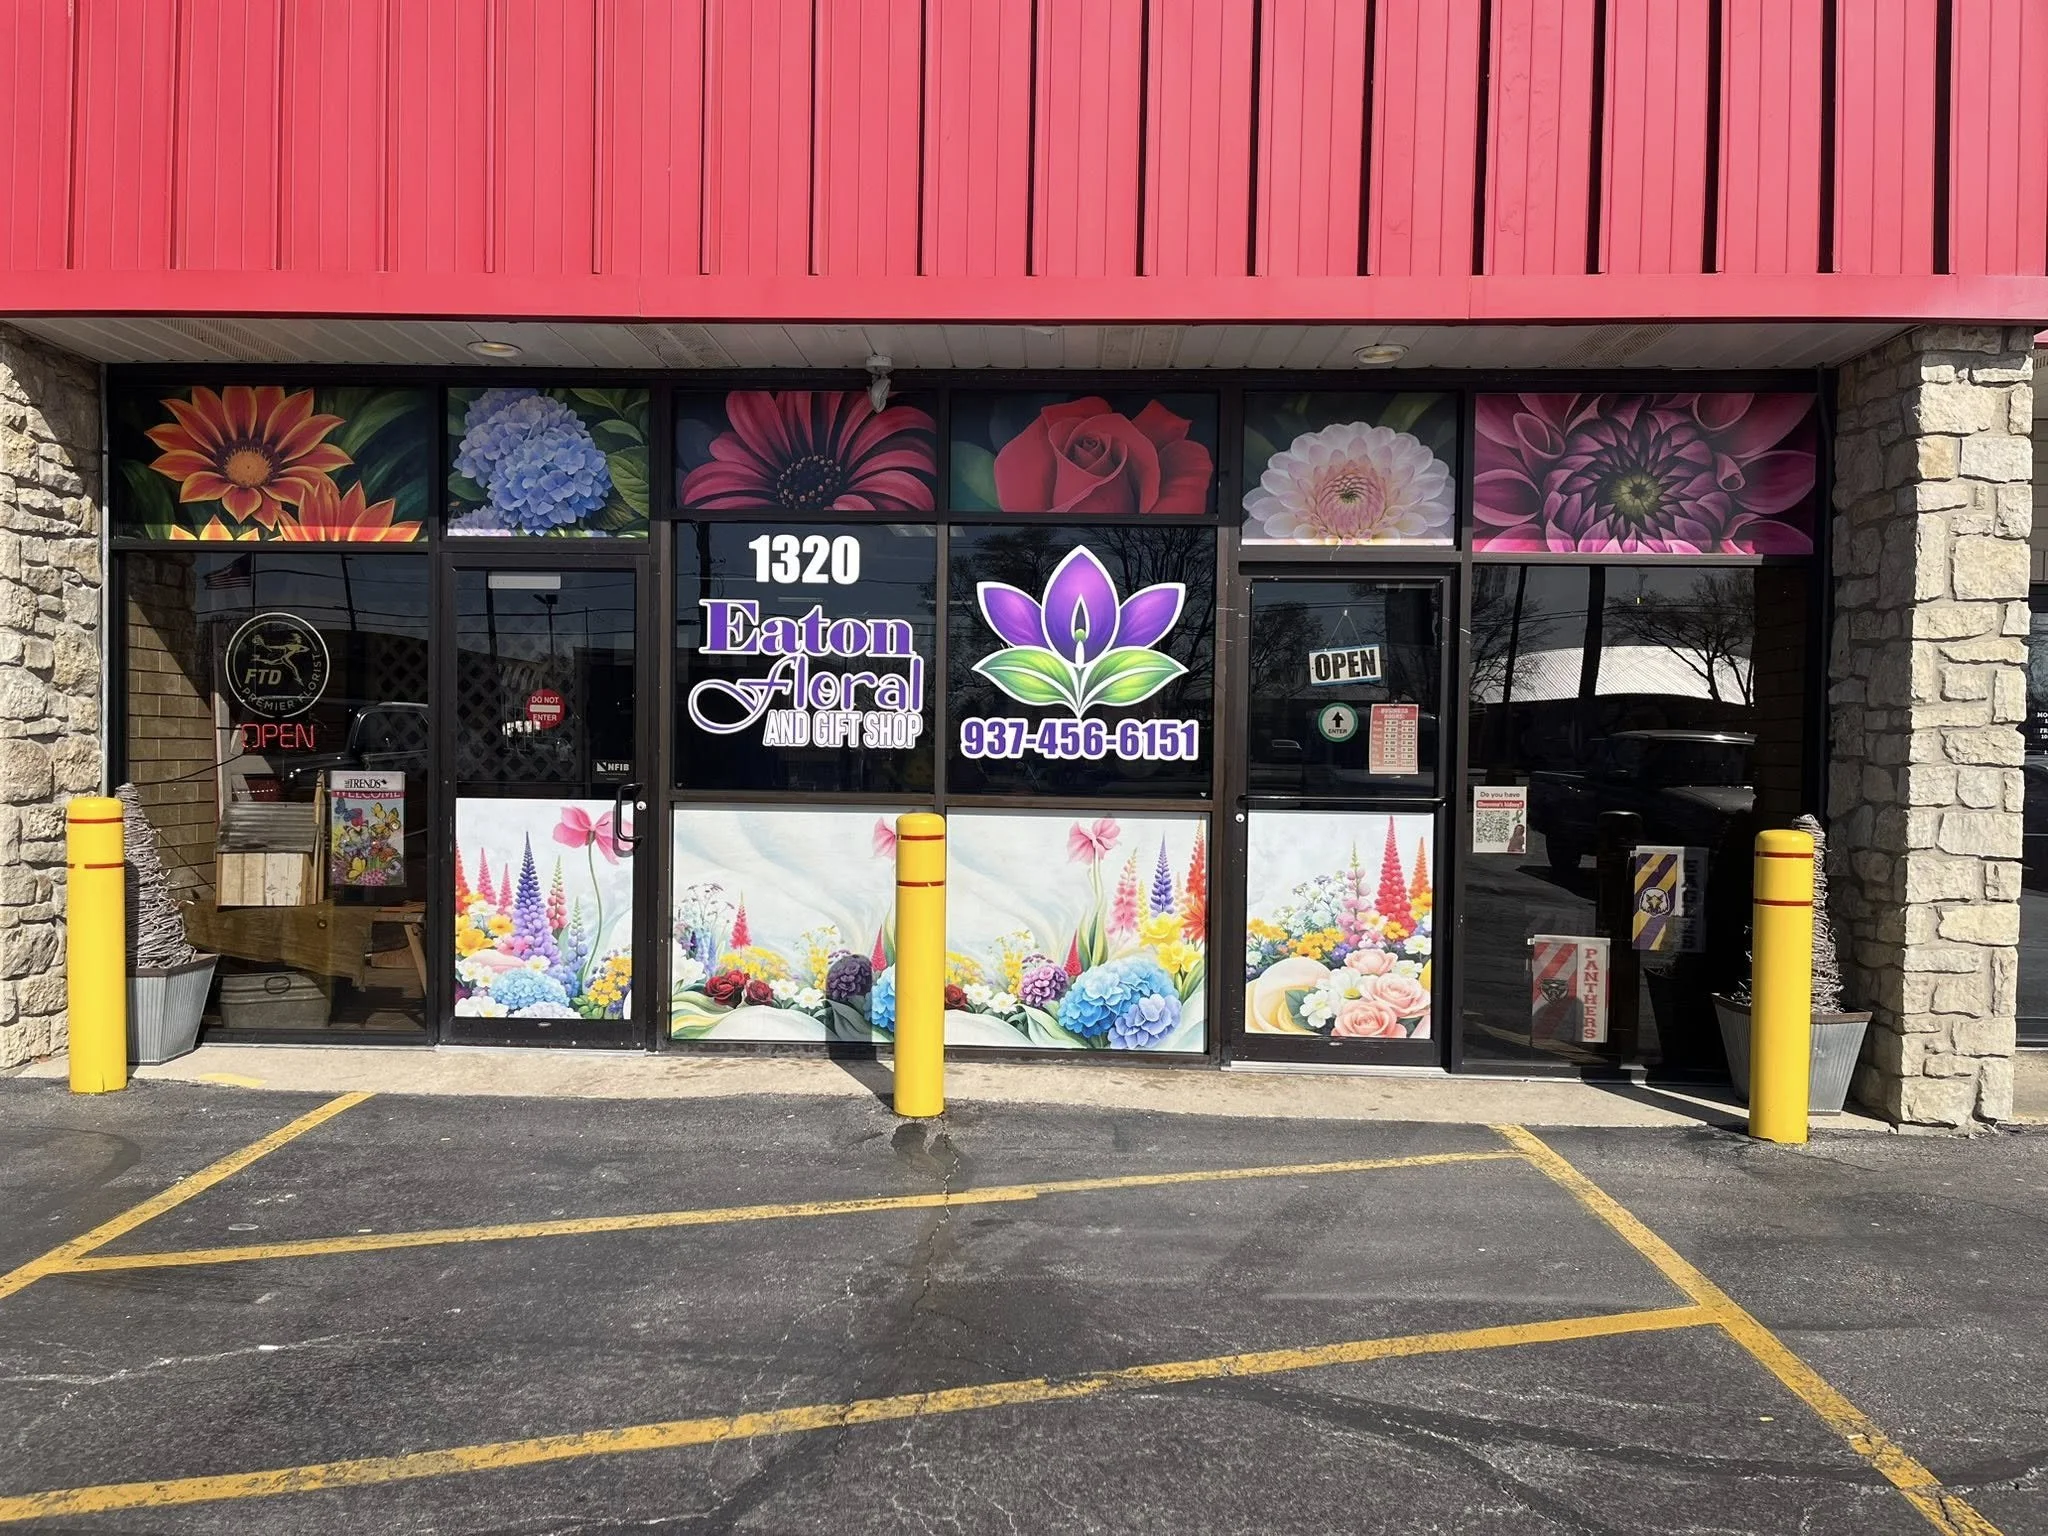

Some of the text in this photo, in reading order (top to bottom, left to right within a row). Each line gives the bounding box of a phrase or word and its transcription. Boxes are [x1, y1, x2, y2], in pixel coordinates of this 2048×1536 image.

[748, 534, 861, 586] 1320
[698, 598, 918, 659] Eaton
[244, 668, 283, 686] FTD
[1314, 649, 1377, 681] OPEN
[241, 687, 296, 711] PREMIER
[531, 696, 559, 704] DO NOT
[532, 713, 557, 721] ENTER
[762, 709, 924, 749] AND GIFT SHOP
[241, 723, 316, 749] OPEN
[960, 717, 1200, 761] 937-456-6151
[607, 763, 629, 771] NFIB
[348, 778, 382, 789] TRENDS
[1583, 947, 1600, 1039] PANTHERS
